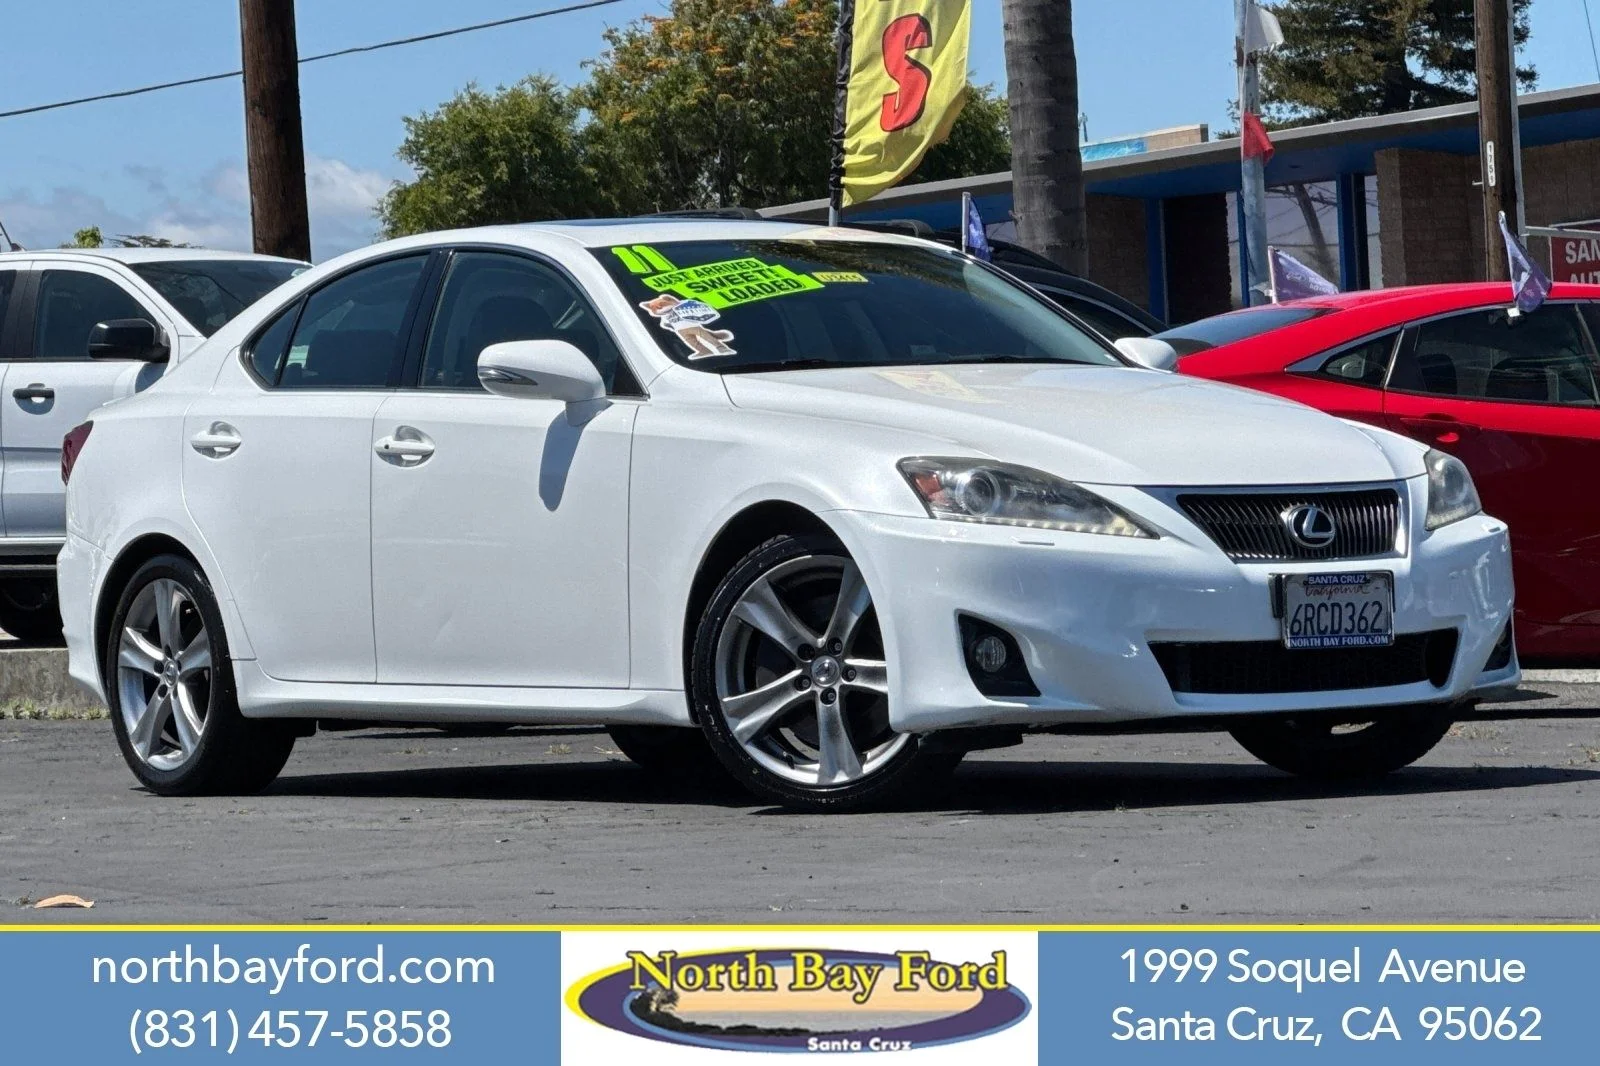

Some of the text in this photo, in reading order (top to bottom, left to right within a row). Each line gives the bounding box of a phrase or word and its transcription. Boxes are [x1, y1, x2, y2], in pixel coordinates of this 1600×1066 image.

[611, 245, 678, 273] 11
[652, 260, 760, 287] JUST ARRIVED
[686, 267, 780, 293] SWEET!
[717, 277, 804, 302] LOADED
[1308, 575, 1365, 585] SANTA CRUZ
[1290, 601, 1383, 636] 6RCD362
[1290, 635, 1389, 648] NORTH BAY FORD.COM
